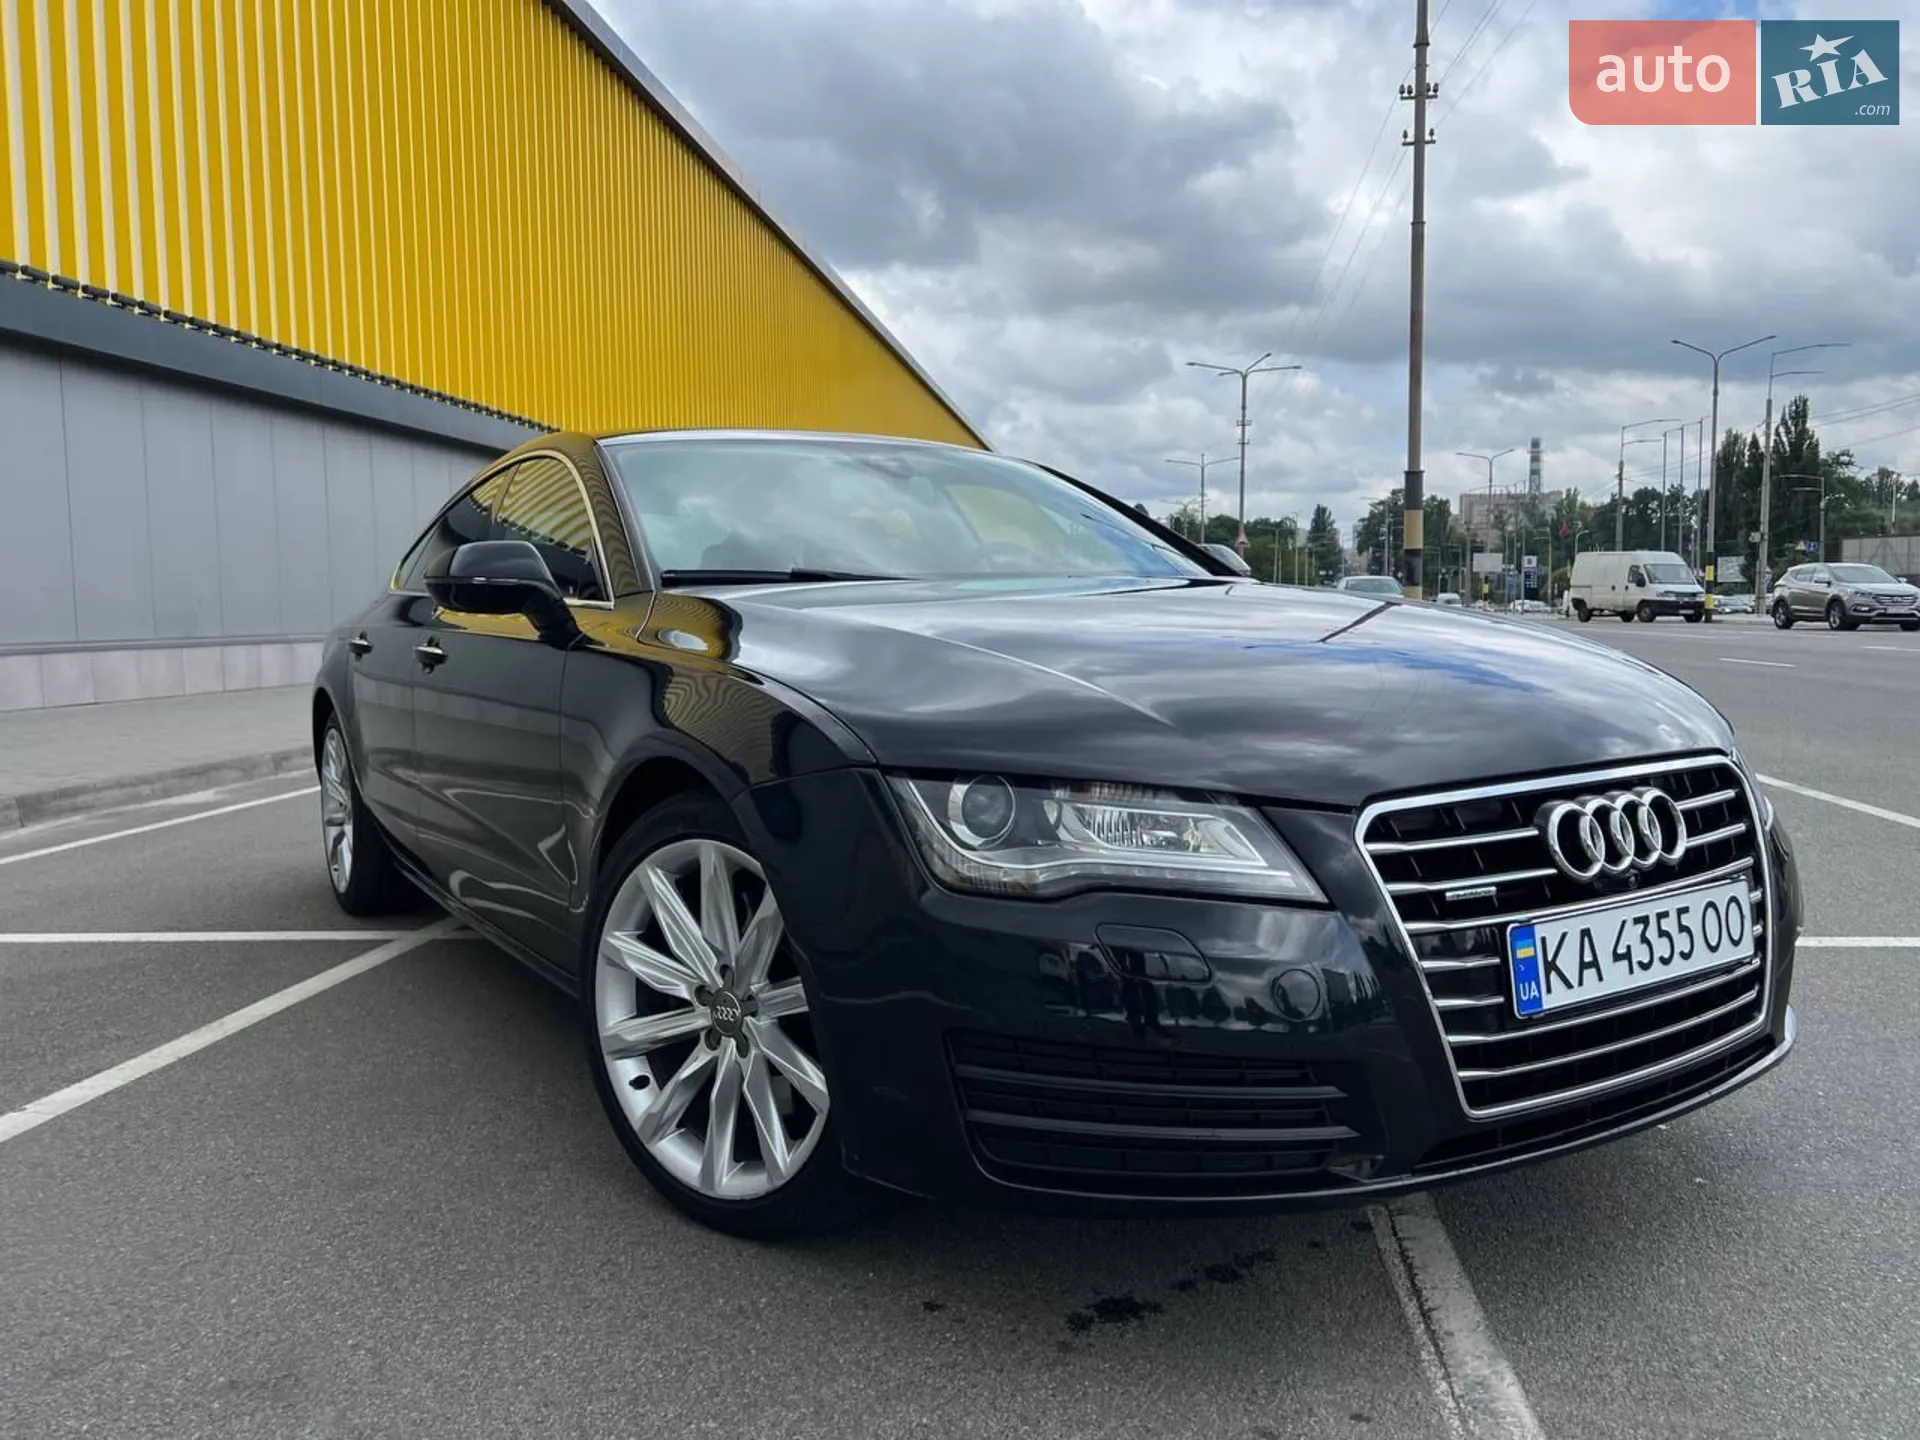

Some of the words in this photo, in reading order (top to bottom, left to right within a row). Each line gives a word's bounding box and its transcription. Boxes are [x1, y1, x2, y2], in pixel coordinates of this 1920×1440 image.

[1541, 927, 1604, 994] KA
[1613, 906, 1694, 975] 4355
[1520, 983, 1539, 1001] UA
